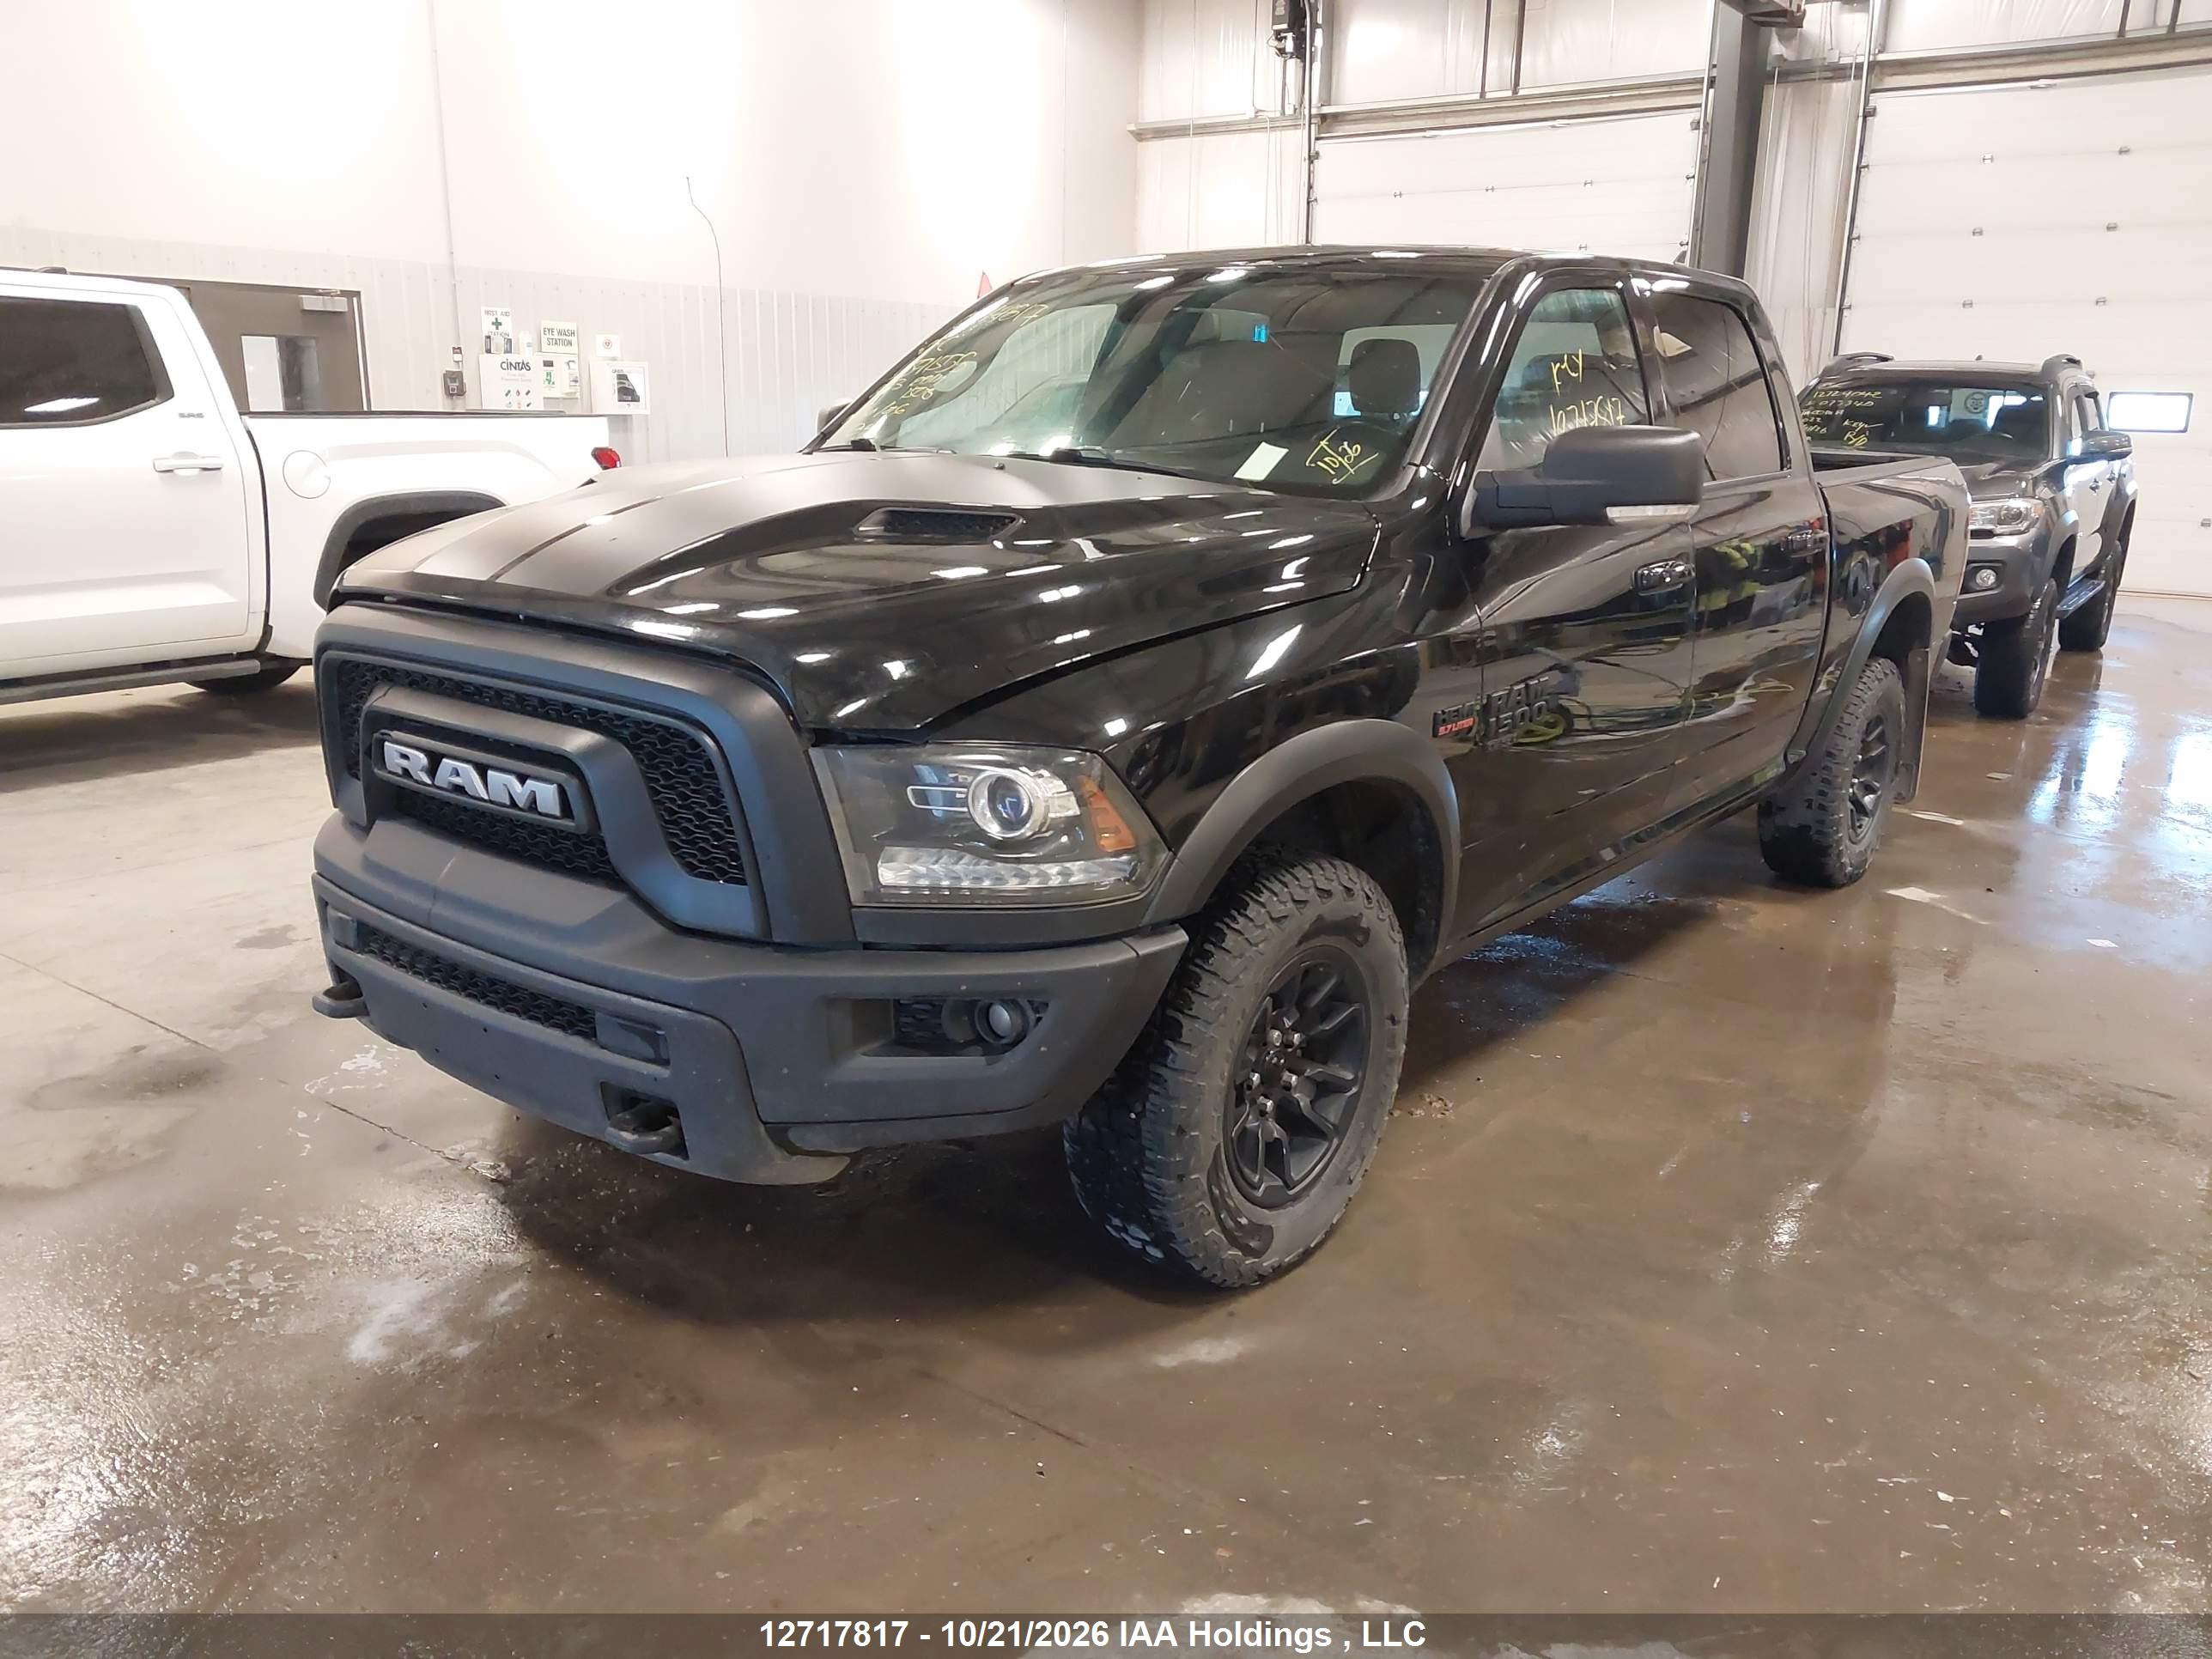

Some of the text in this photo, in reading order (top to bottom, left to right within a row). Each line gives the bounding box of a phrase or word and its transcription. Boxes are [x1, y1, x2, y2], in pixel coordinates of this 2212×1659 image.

[543, 327, 576, 337] EYE WASH
[546, 337, 573, 348] STATION
[384, 741, 561, 817] RAM
